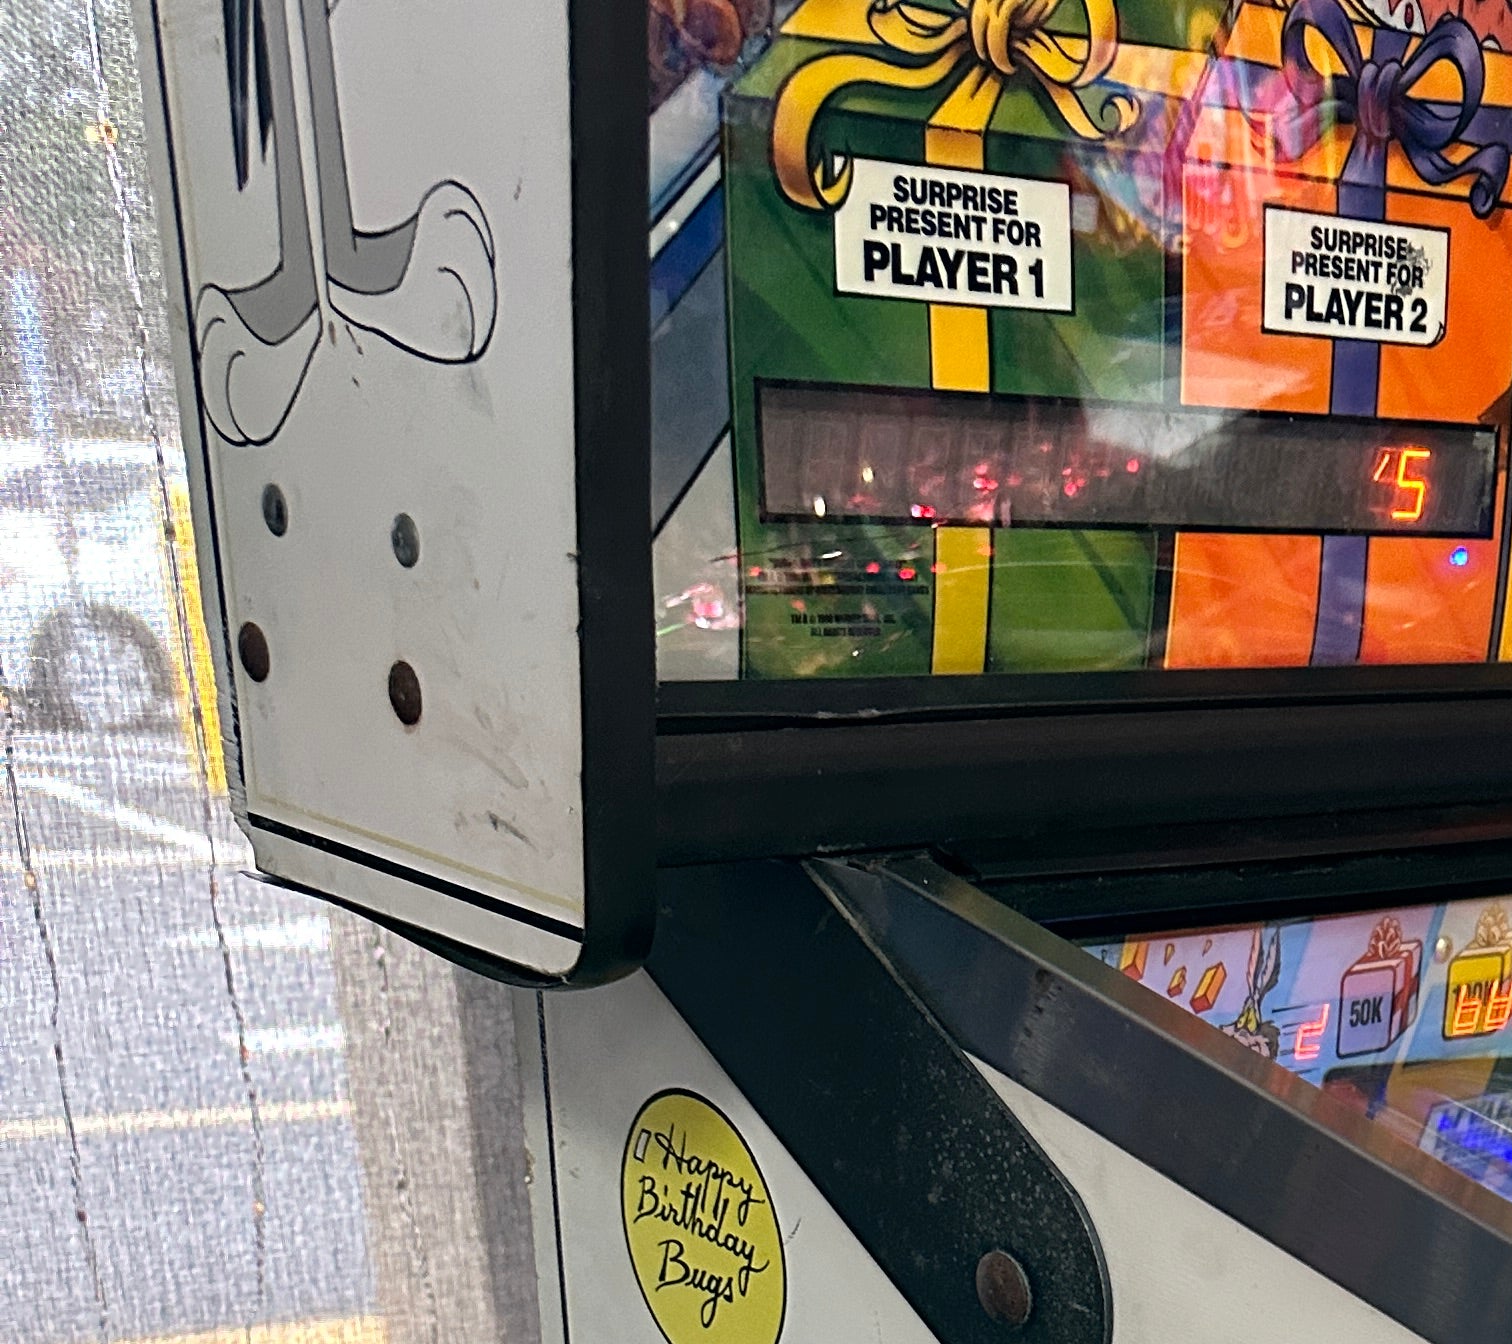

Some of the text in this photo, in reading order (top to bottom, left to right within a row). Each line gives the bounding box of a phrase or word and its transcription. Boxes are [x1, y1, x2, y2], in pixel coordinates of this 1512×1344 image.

[893, 175, 1018, 216] SURPRISE
[870, 203, 1041, 248] PRESENT FOR
[1311, 226, 1408, 260] SURPRISE
[863, 239, 1045, 299] PLAYER 1
[1292, 250, 1424, 288] PRESENT FOR
[1284, 282, 1428, 333] PLAYER 2
[1349, 996, 1384, 1028] 50K
[654, 1122, 766, 1227] Happy
[633, 1174, 770, 1297] Birthday
[655, 1238, 734, 1329] Bugs
